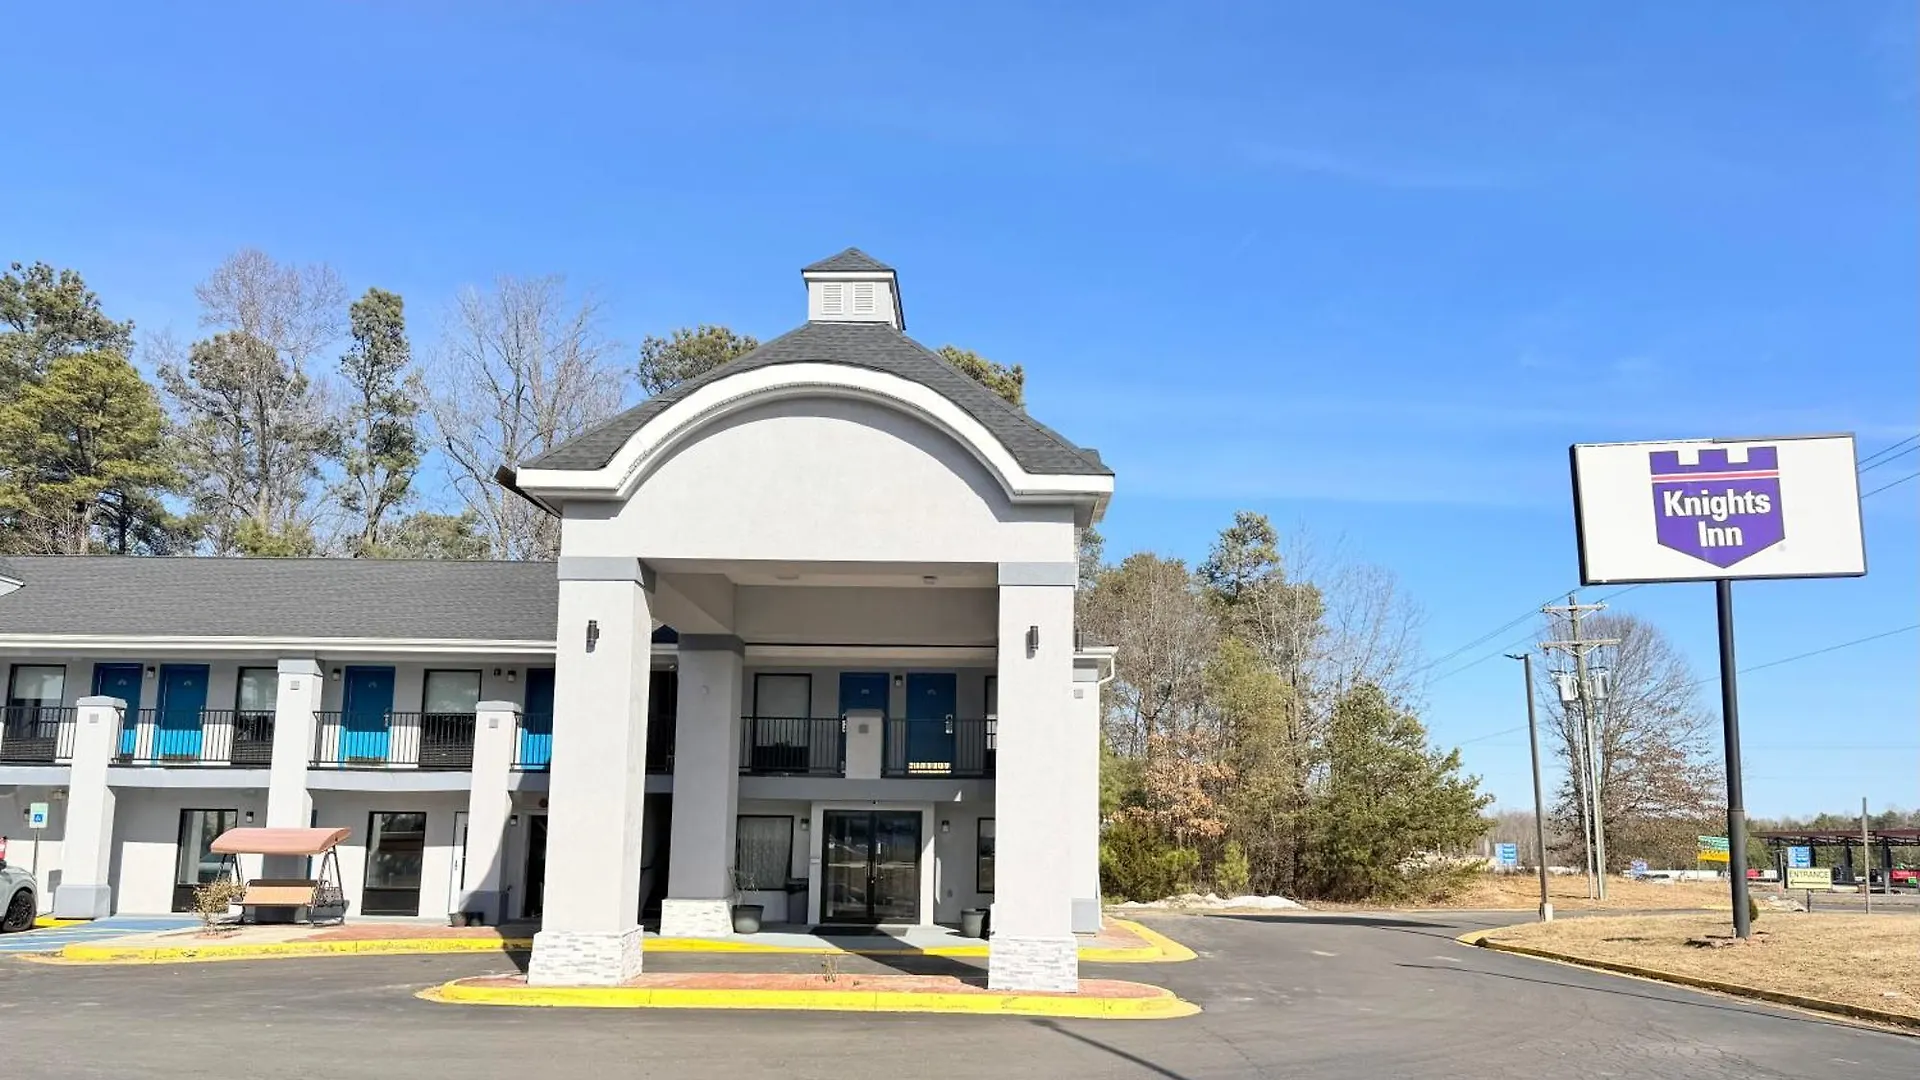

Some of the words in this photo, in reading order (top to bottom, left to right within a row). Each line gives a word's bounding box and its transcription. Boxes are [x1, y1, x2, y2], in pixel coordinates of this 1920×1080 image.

[1663, 488, 1771, 521] Knights
[1698, 520, 1743, 547] Inn
[1789, 870, 1830, 879] ENTRANCE
